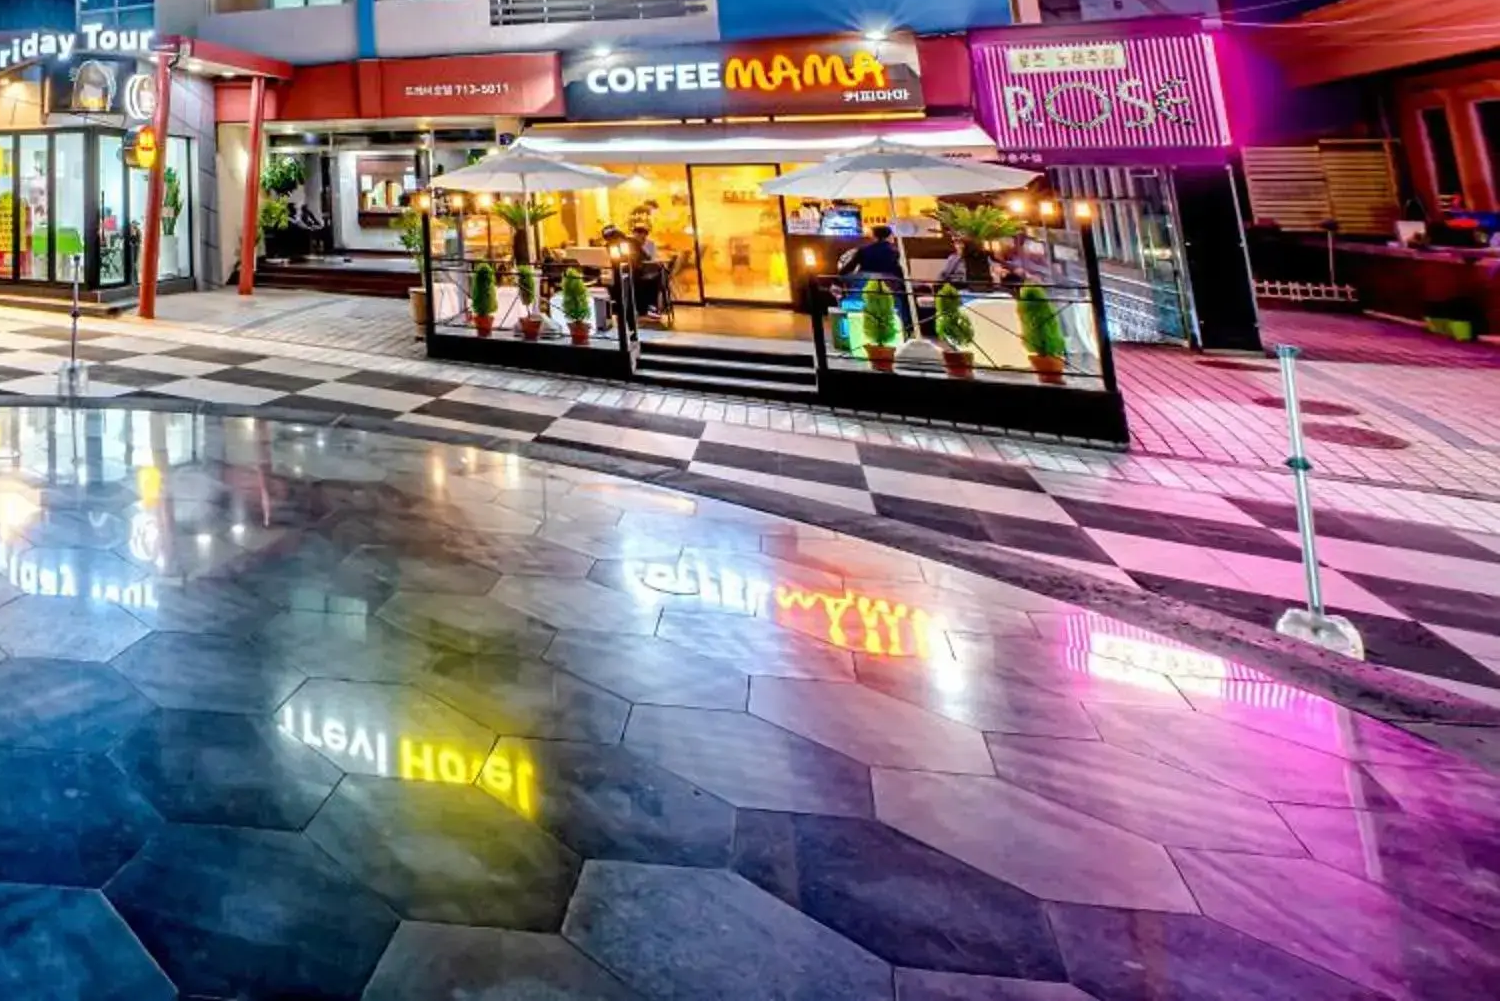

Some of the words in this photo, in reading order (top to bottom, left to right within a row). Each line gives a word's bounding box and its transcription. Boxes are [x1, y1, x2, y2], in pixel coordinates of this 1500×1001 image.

[82, 23, 156, 51] Tour
[455, 82, 509, 95] 713-5011
[586, 62, 722, 94] COFFEE
[725, 50, 885, 91] MAMA
[1003, 75, 1195, 131] ROSE
